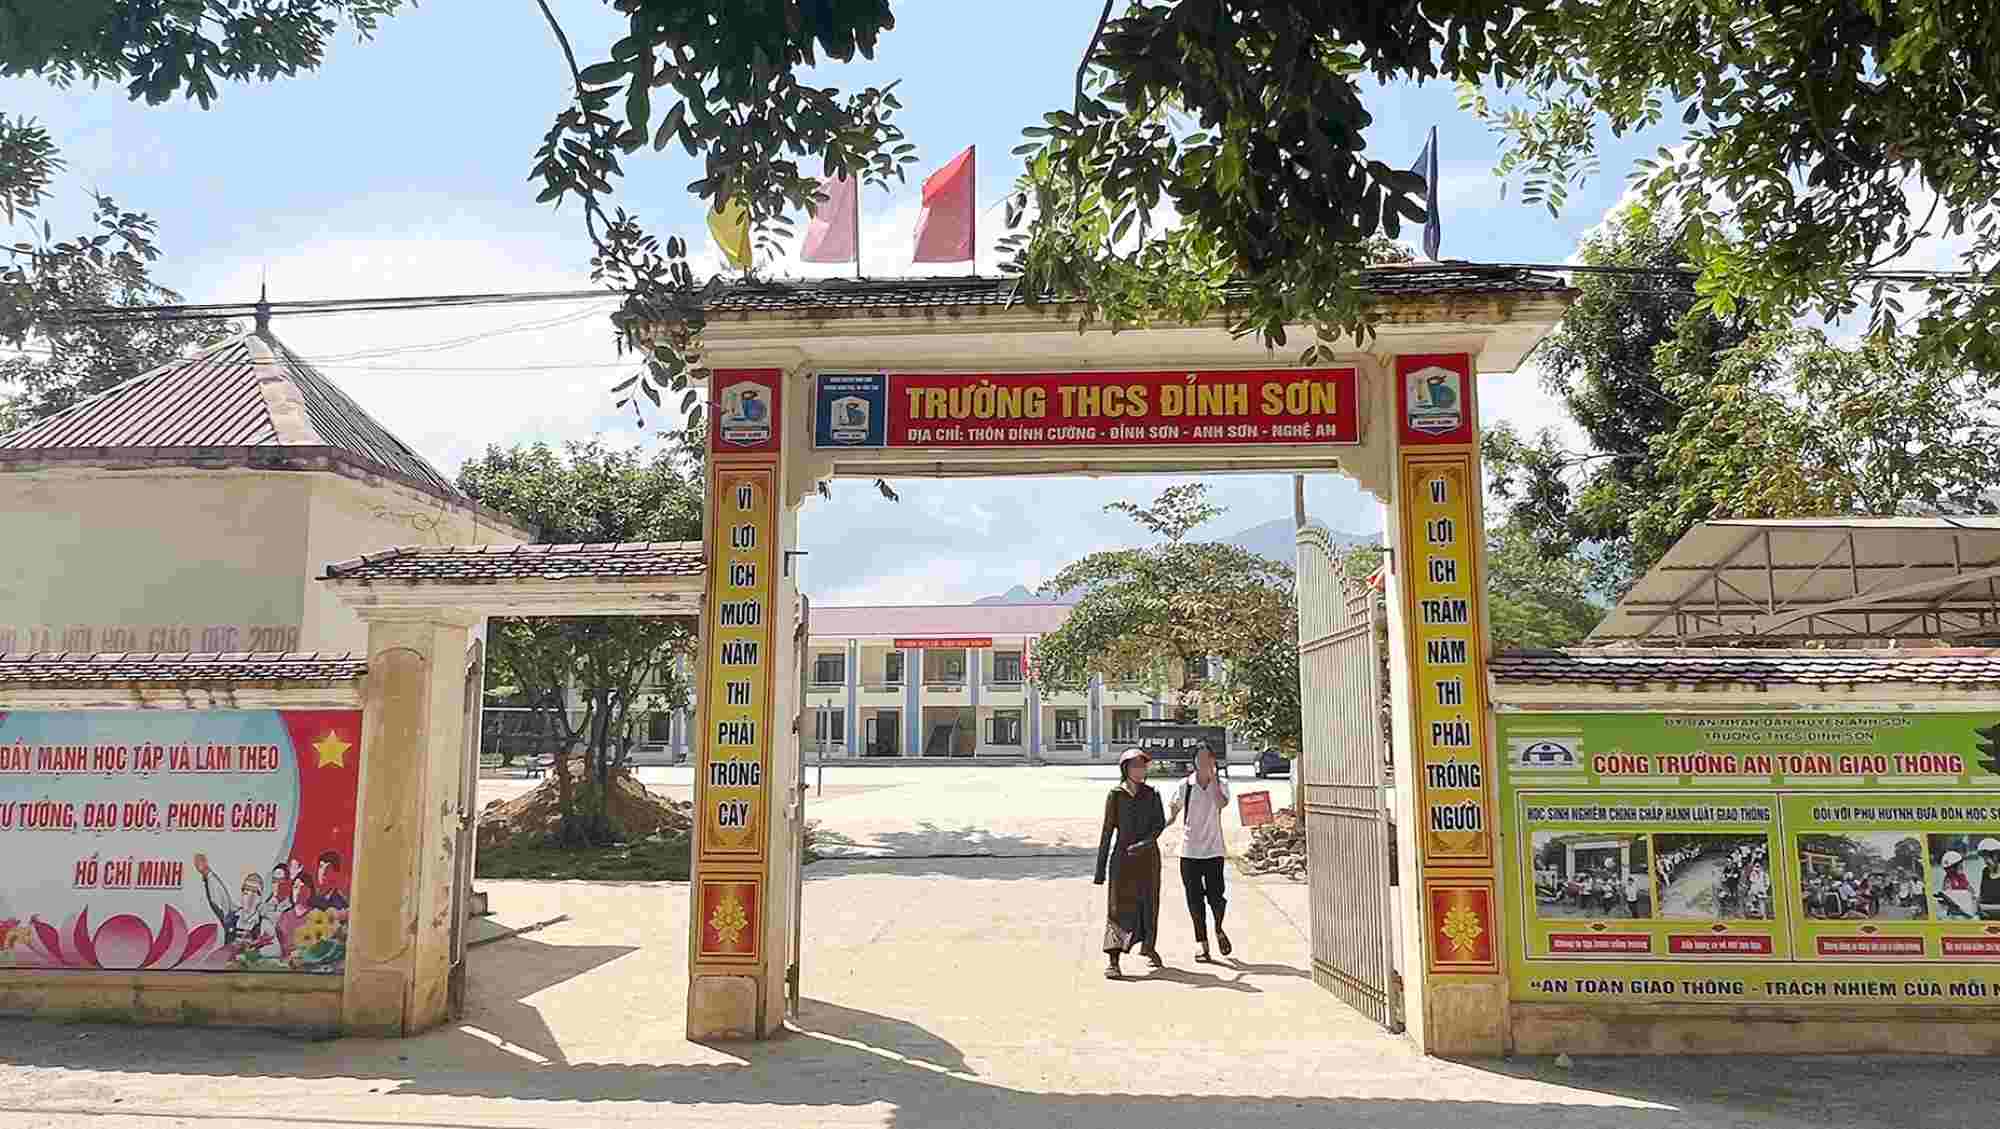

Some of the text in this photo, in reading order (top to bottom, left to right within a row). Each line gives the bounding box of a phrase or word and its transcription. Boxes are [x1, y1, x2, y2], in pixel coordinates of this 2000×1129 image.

[905, 378, 1047, 420] TRƯỜNG
[1057, 383, 1149, 419] THCS
[1260, 380, 1337, 416] SƠN
[967, 426, 1005, 441] THÔN
[1149, 424, 1180, 440] SƠN
[1192, 424, 1224, 439] ANH
[1227, 422, 1259, 438] SƠN
[1271, 421, 1313, 439] NGHỆ
[1315, 423, 1337, 437] AN
[736, 483, 752, 510] VÌ
[1429, 475, 1446, 503] VÌ
[731, 522, 756, 552] LỢI
[1427, 518, 1454, 548] LỢI
[730, 560, 756, 587] ÍCH
[1428, 555, 1457, 583] ÍCH
[720, 599, 760, 626] MƯỜI
[1421, 596, 1467, 623] TRĂM
[720, 638, 758, 665] NĂM
[1427, 634, 1466, 663] NĂM
[726, 677, 751, 705] THÌ
[1435, 676, 1462, 705] THÌ
[37, 744, 89, 776] MẠNH
[93, 744, 129, 776] HỌC
[132, 741, 165, 776] TẬP
[168, 739, 192, 771] VÀ
[195, 739, 233, 771] LÀM
[237, 744, 280, 771] THEO
[1655, 752, 1738, 774] TRƯỜNG
[1743, 754, 1772, 774] AN
[1777, 751, 1833, 774] TOÀN
[1839, 754, 1889, 774] GIAO
[1893, 753, 1964, 774] THÔNG
[0, 799, 17, 828] Ư
[82, 801, 119, 834] ĐẠO
[166, 801, 226, 829] PHONG
[230, 797, 279, 829] CÁCH
[718, 798, 749, 827] CÂY
[1430, 800, 1482, 831] NGƯỜI
[102, 855, 134, 887] CHÍ
[136, 860, 184, 887] MINH
[1575, 977, 1624, 994] TOÀN
[1630, 979, 1676, 994] GIAO
[1681, 977, 1745, 995] THÔNG
[1765, 978, 1827, 996] TRÁCH
